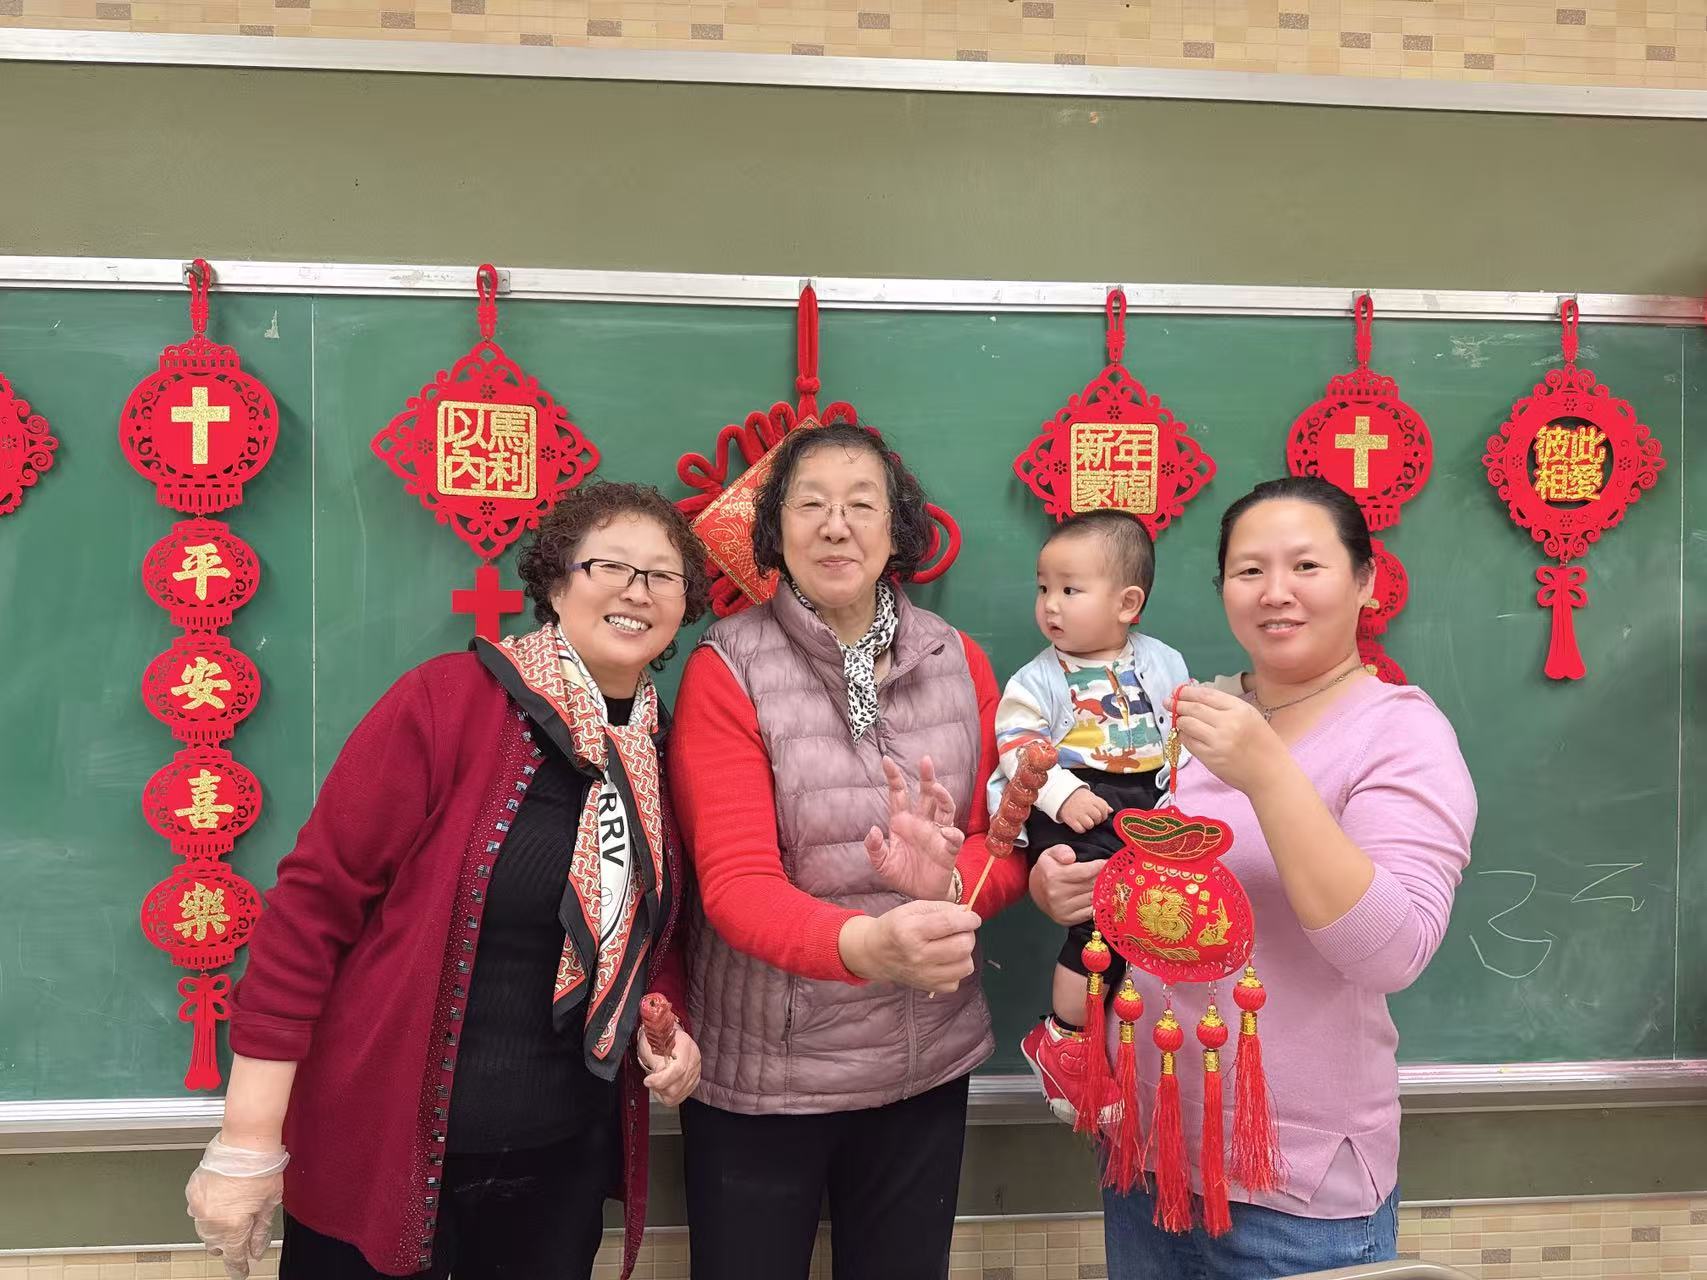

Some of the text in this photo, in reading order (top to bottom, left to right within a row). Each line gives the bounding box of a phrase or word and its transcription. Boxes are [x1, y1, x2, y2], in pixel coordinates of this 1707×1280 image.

[444, 407, 530, 453] 以馬
[1076, 428, 1153, 471] 新年
[1535, 426, 1606, 463] 彼此
[1535, 463, 1603, 500] 相愛
[172, 542, 234, 941] 平安喜樂
